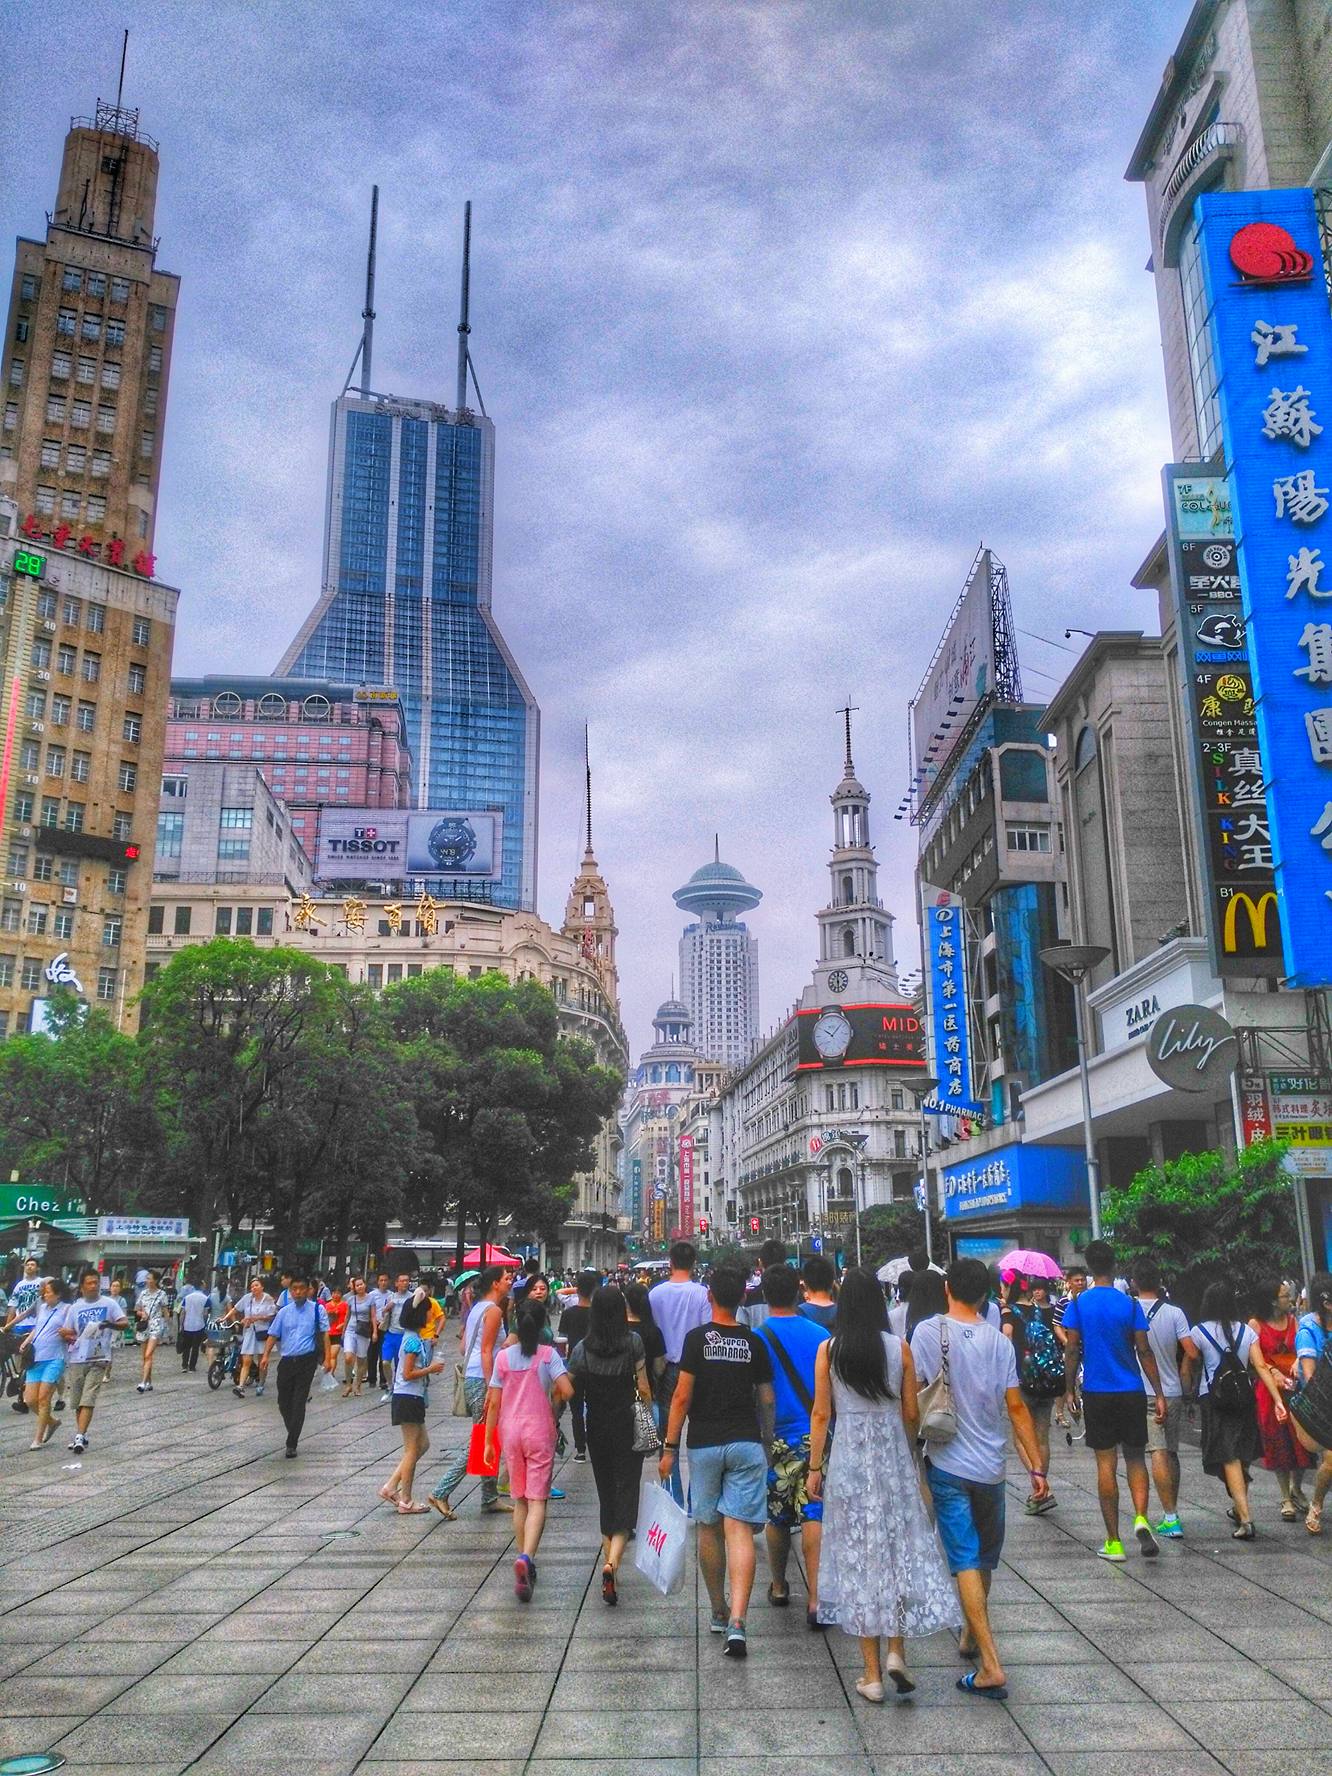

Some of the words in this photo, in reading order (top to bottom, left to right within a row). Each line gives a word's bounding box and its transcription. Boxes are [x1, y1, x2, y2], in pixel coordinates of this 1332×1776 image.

[1182, 543, 1196, 552] 6F
[1190, 605, 1204, 615] 5F
[44, 622, 57, 632] 40
[38, 670, 51, 681] 30
[1196, 674, 1212, 684] 4F
[32, 722, 45, 732] 20
[1202, 742, 1232, 752] 2-3F
[26, 775, 39, 785] 10
[328, 840, 400, 853] TISSOT
[1220, 887, 1234, 897] B1
[1126, 995, 1160, 1026] ZARA
[1158, 1019, 1236, 1070] Lily
[16, 1196, 60, 1212] Chez
